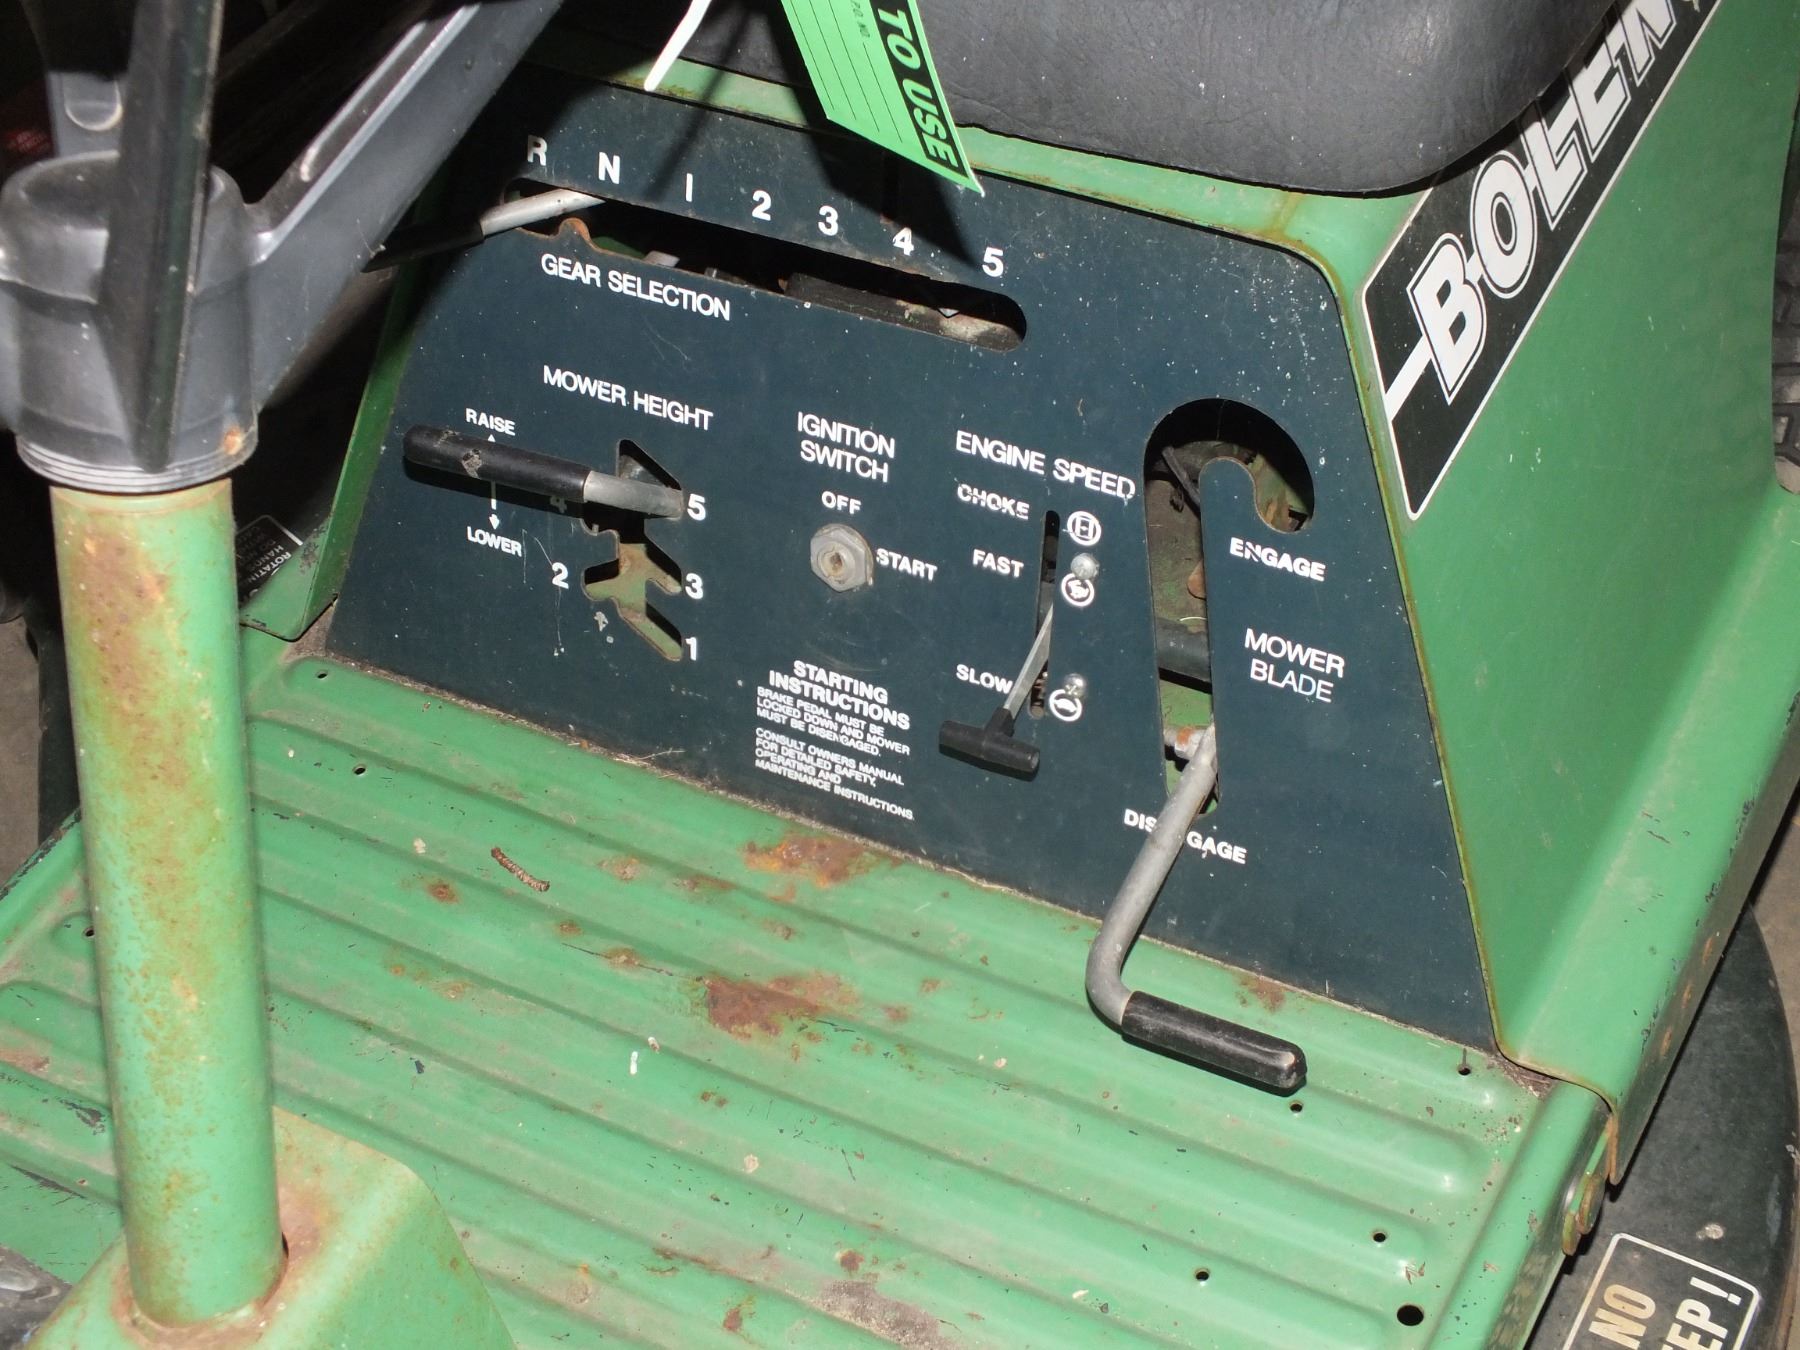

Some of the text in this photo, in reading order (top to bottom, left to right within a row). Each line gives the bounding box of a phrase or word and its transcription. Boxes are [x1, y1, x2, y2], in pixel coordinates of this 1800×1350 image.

[878, 8, 959, 168] TO USE
[527, 135, 548, 166] R
[598, 152, 621, 185] N
[752, 190, 772, 221] 2
[818, 206, 839, 237] 3
[892, 226, 915, 256] 4
[982, 246, 1004, 278] 5
[1406, 0, 1678, 405] BOLEN
[541, 253, 731, 321] GEAR SELECTION
[543, 365, 714, 431] MOWER HEIGHT
[465, 408, 516, 436] RAISE
[797, 411, 896, 459] IGNITION
[800, 439, 890, 483] SWITCH
[956, 430, 1136, 501] ENGINE SPEED
[687, 493, 706, 521] 5
[821, 491, 862, 515] OFF
[957, 484, 1030, 520] CHOKE
[466, 526, 522, 557] LOWER
[973, 548, 1024, 578] FAST
[1229, 537, 1326, 582] ENGAGE
[246, 551, 292, 583] ROTATIN
[552, 562, 569, 589] 2
[685, 573, 704, 599] 3
[876, 547, 938, 582] START
[685, 636, 697, 661] 1
[1244, 628, 1345, 678] MOWER
[769, 670, 910, 730] INSTRUCTIONS
[793, 660, 889, 705] STARTING
[956, 664, 1014, 695] SLOW
[1250, 658, 1334, 703] BLADE
[756, 697, 910, 756] LOCKED DOWN AND MOWER
[756, 707, 881, 757] MUST BE DISENGAGED.
[757, 686, 885, 737] BRAKE PEDAL MUST BE
[755, 738, 779, 755] FOR
[780, 746, 832, 771] DETAILED
[755, 727, 905, 786] CONSULT OWNERS MANUAL
[755, 748, 842, 784] OPERATING AND
[755, 759, 831, 792] MAINTENANCE
[1124, 808, 1247, 865] DISGAGE
[1588, 1284, 1656, 1350] NO
[1662, 1276, 1742, 1350] EP!
